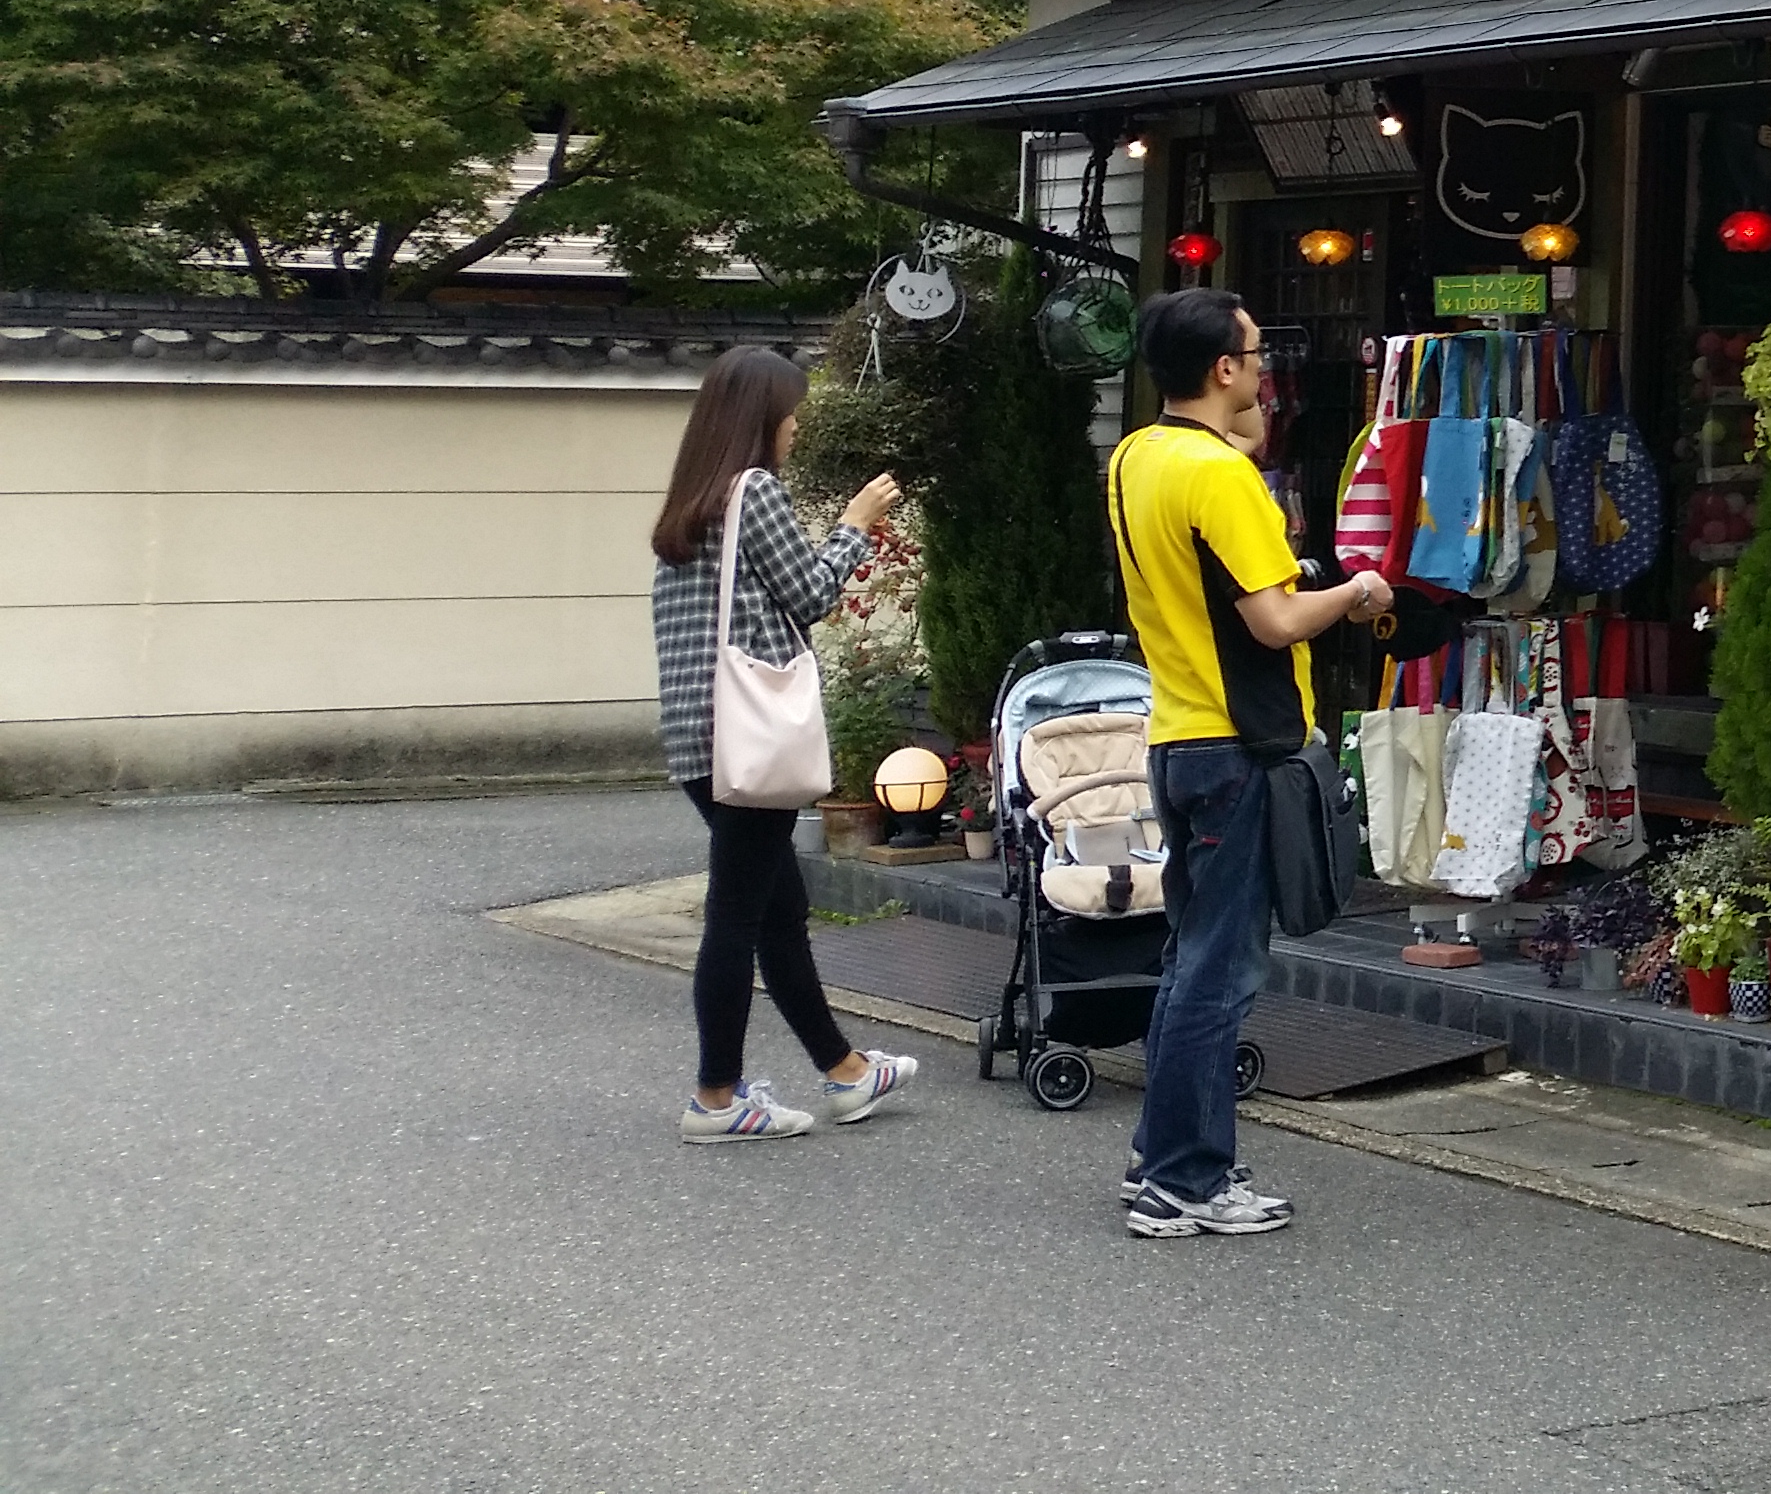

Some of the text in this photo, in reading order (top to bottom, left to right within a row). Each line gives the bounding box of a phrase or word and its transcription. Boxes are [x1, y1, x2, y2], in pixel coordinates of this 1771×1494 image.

[1438, 275, 1541, 294] トートバッグ
